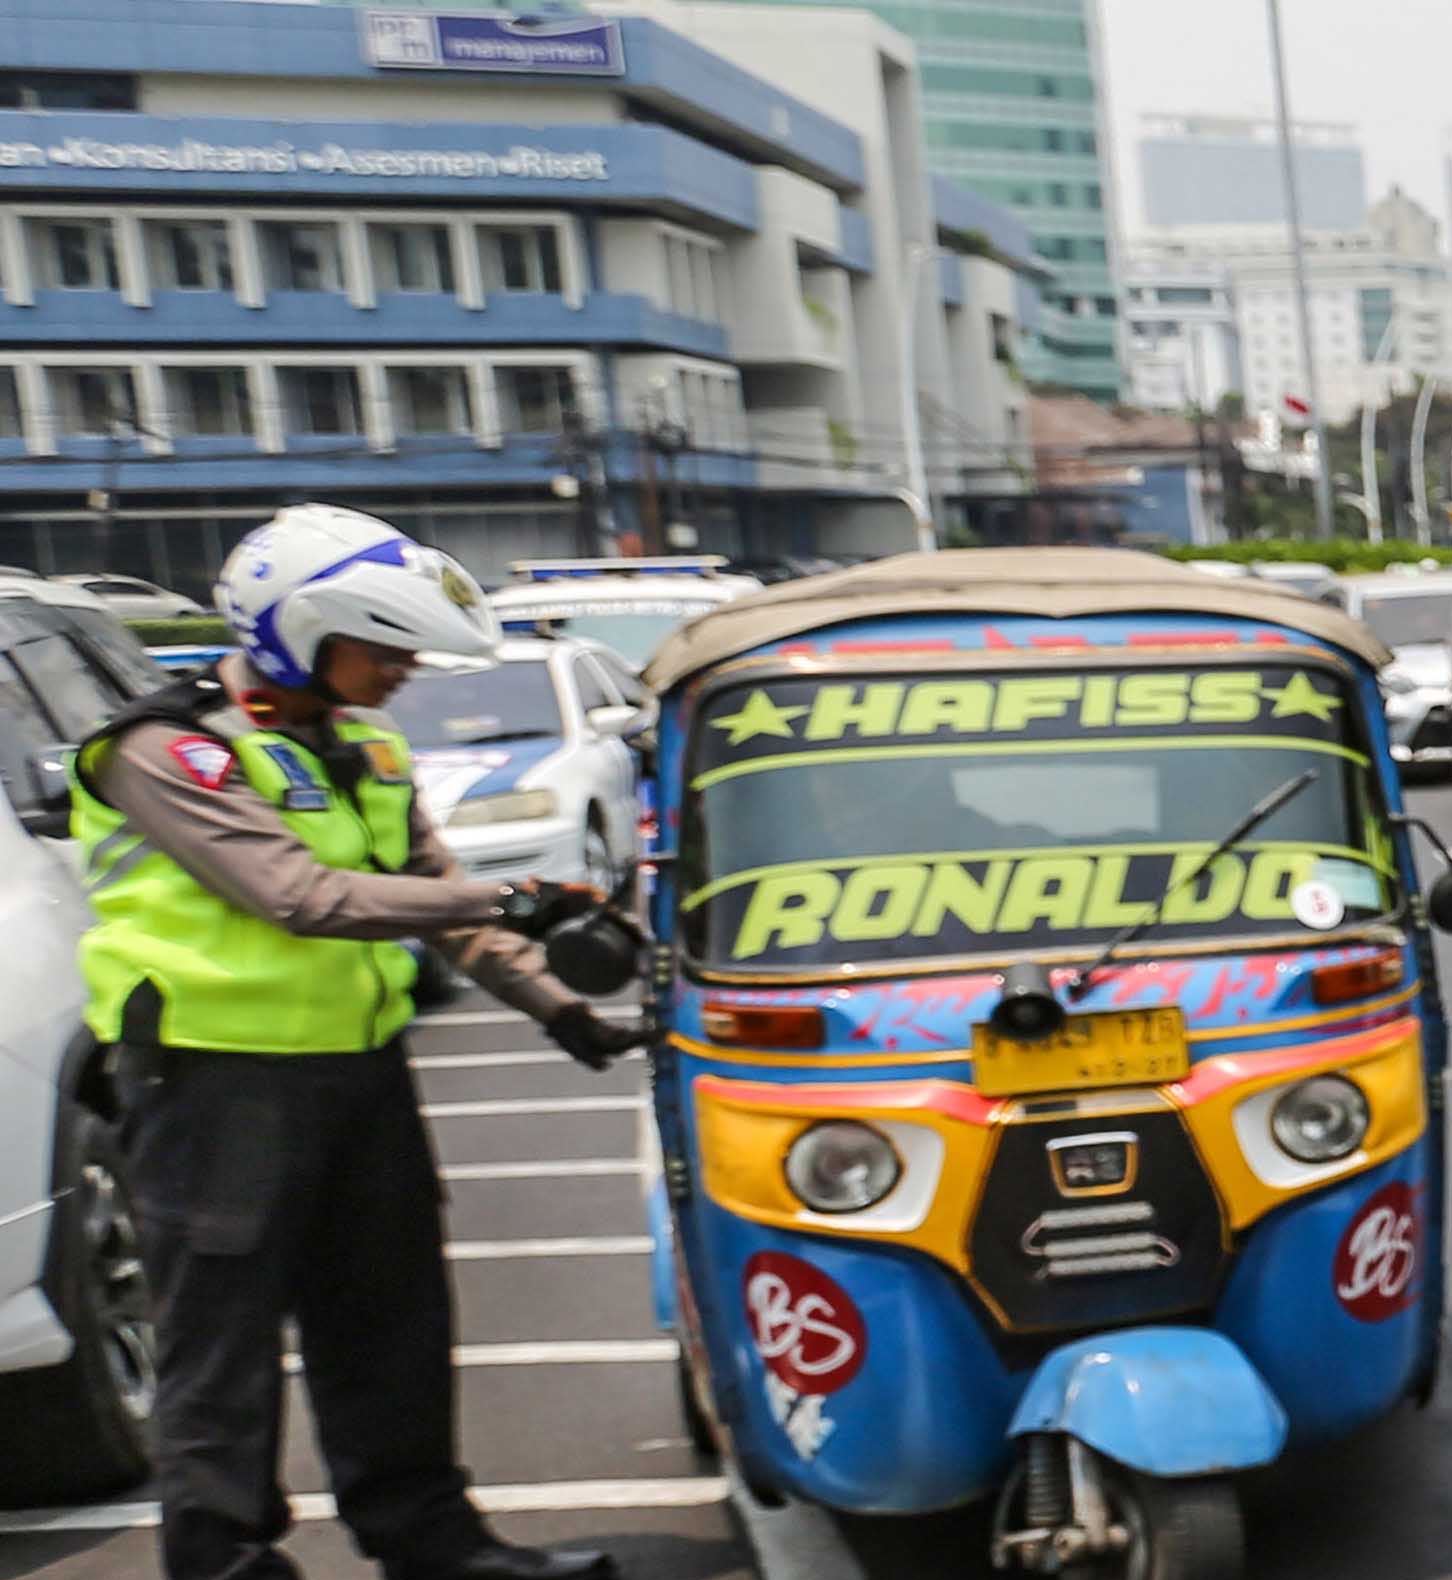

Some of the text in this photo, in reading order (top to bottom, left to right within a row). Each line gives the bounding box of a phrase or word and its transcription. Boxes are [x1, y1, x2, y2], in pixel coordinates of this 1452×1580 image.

[452, 37, 606, 65] manajemen
[324, 144, 499, 177] Asesmen
[519, 146, 608, 180] Riset
[805, 671, 1264, 741] HAFISS
[732, 851, 1320, 960] RONALDO
[748, 1271, 856, 1376] BS
